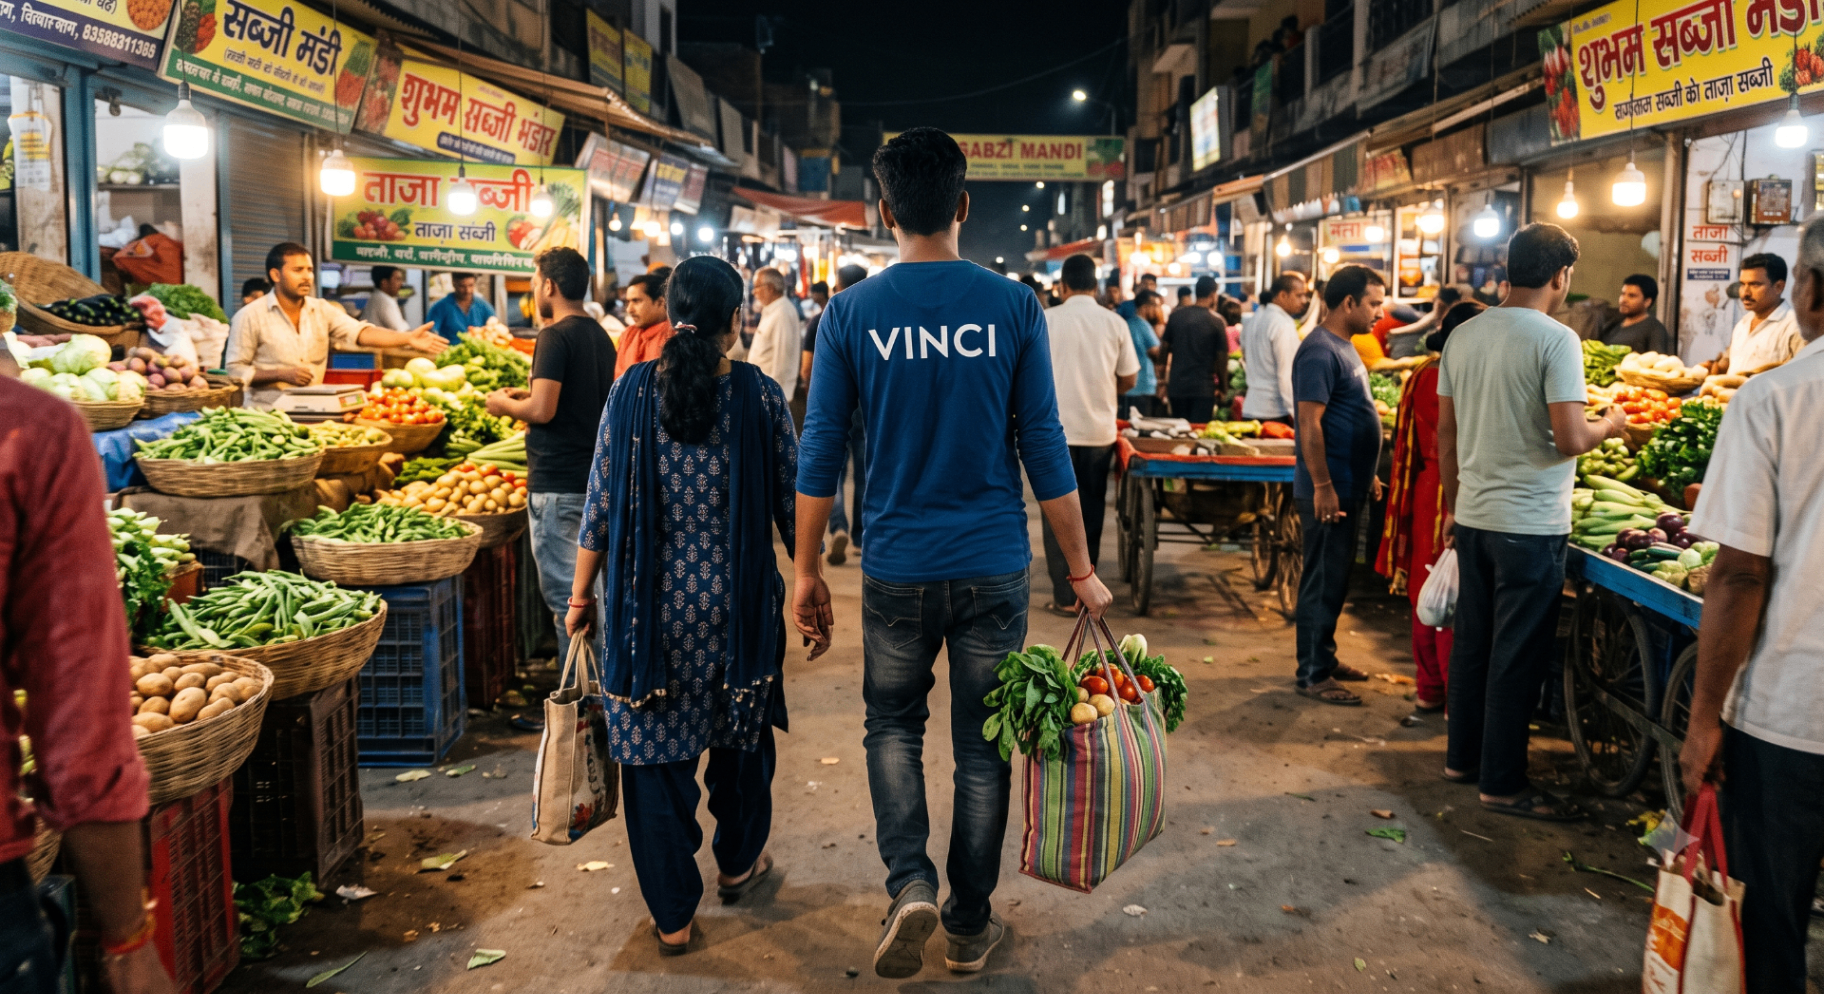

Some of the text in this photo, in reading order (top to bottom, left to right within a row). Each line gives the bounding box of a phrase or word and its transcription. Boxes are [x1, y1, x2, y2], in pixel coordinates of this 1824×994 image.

[223, 0, 295, 58] सब्जी
[296, 25, 342, 76] मंडी
[1578, 24, 1645, 111] शुभम
[401, 72, 461, 127] शुभम
[464, 101, 517, 143] सब्जी
[1020, 142, 1082, 159] MANDI
[363, 168, 534, 212] ताजा ब्जी
[1692, 225, 1728, 239] ताजा
[868, 323, 996, 361] VINCI
